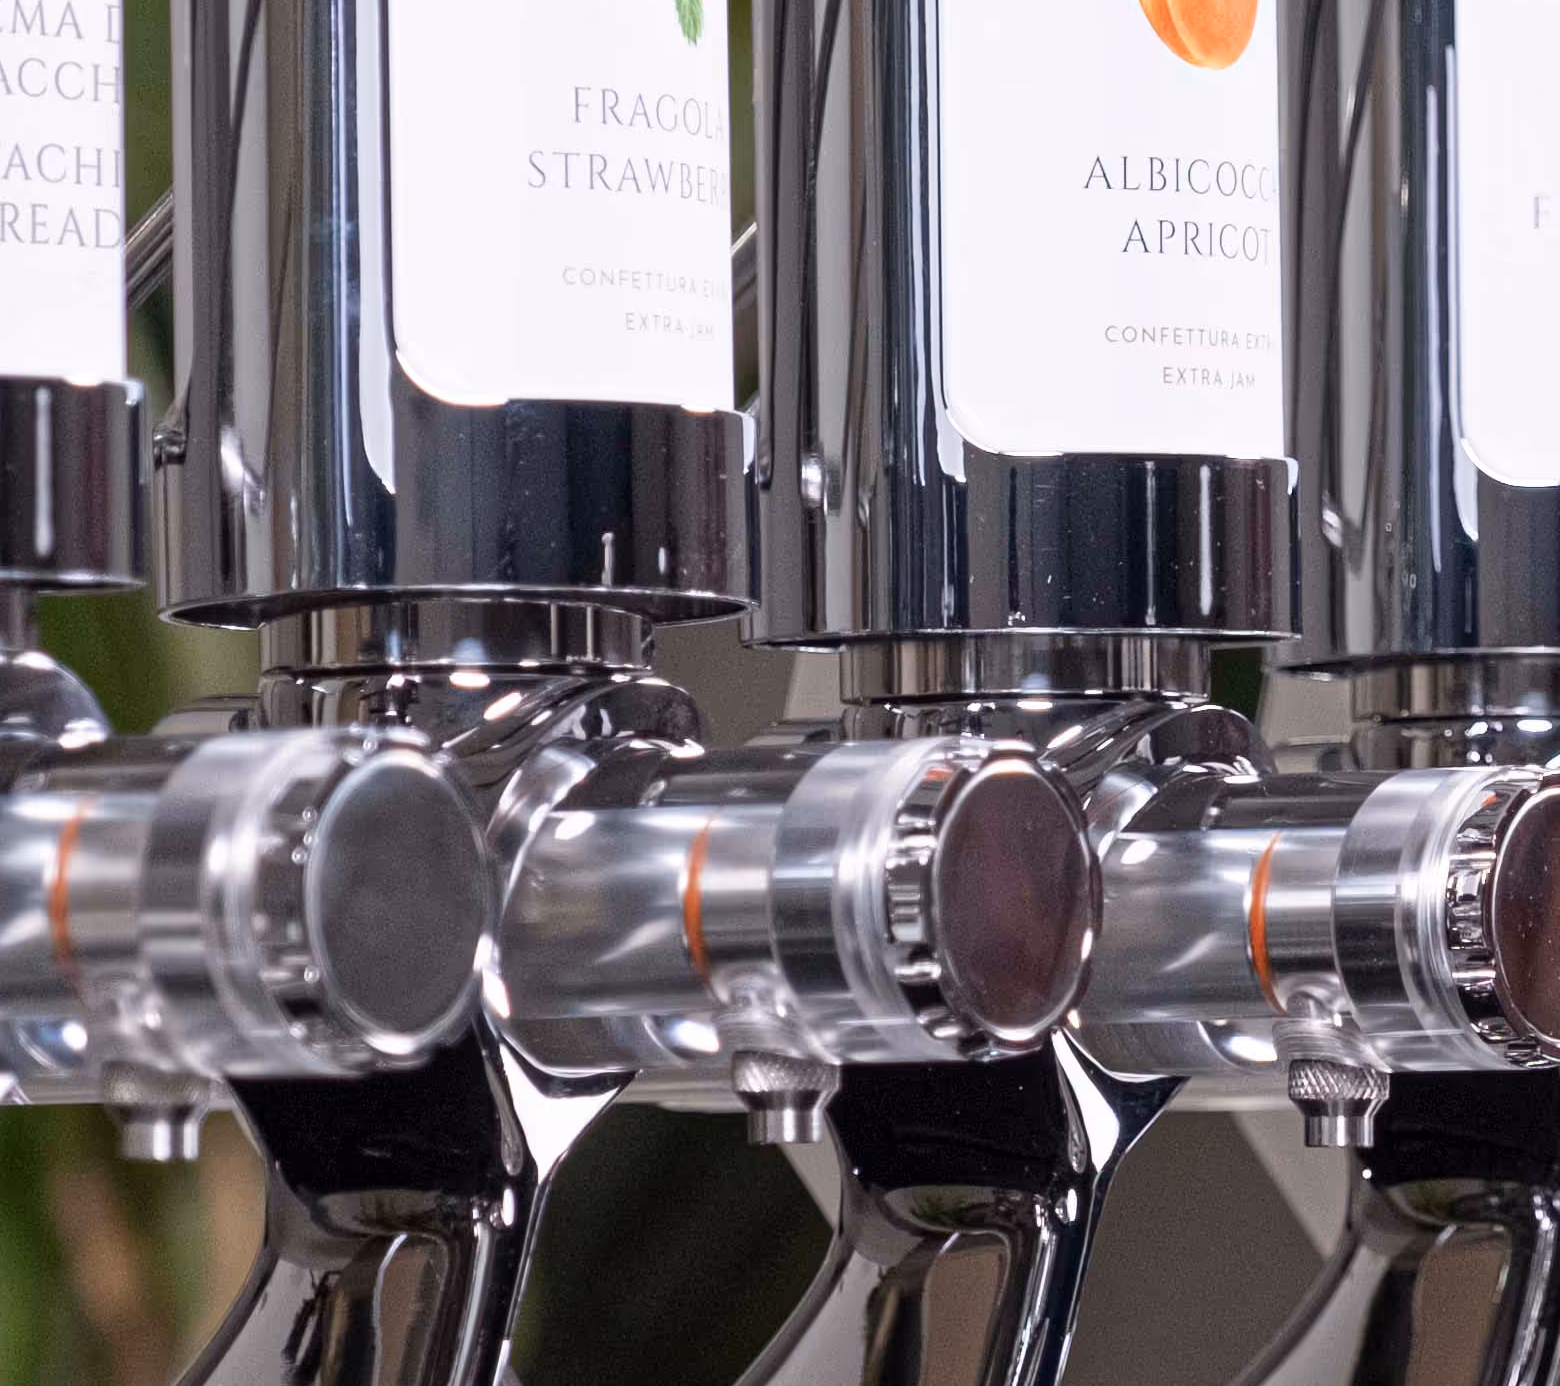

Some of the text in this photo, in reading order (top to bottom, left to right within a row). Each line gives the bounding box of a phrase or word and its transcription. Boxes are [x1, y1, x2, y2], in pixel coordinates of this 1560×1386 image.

[1121, 217, 1272, 268] APRICOT
[625, 312, 685, 334] EXTRA
[1104, 324, 1240, 351] CONFETTURA
[1162, 366, 1256, 390] EXTRA JAM
